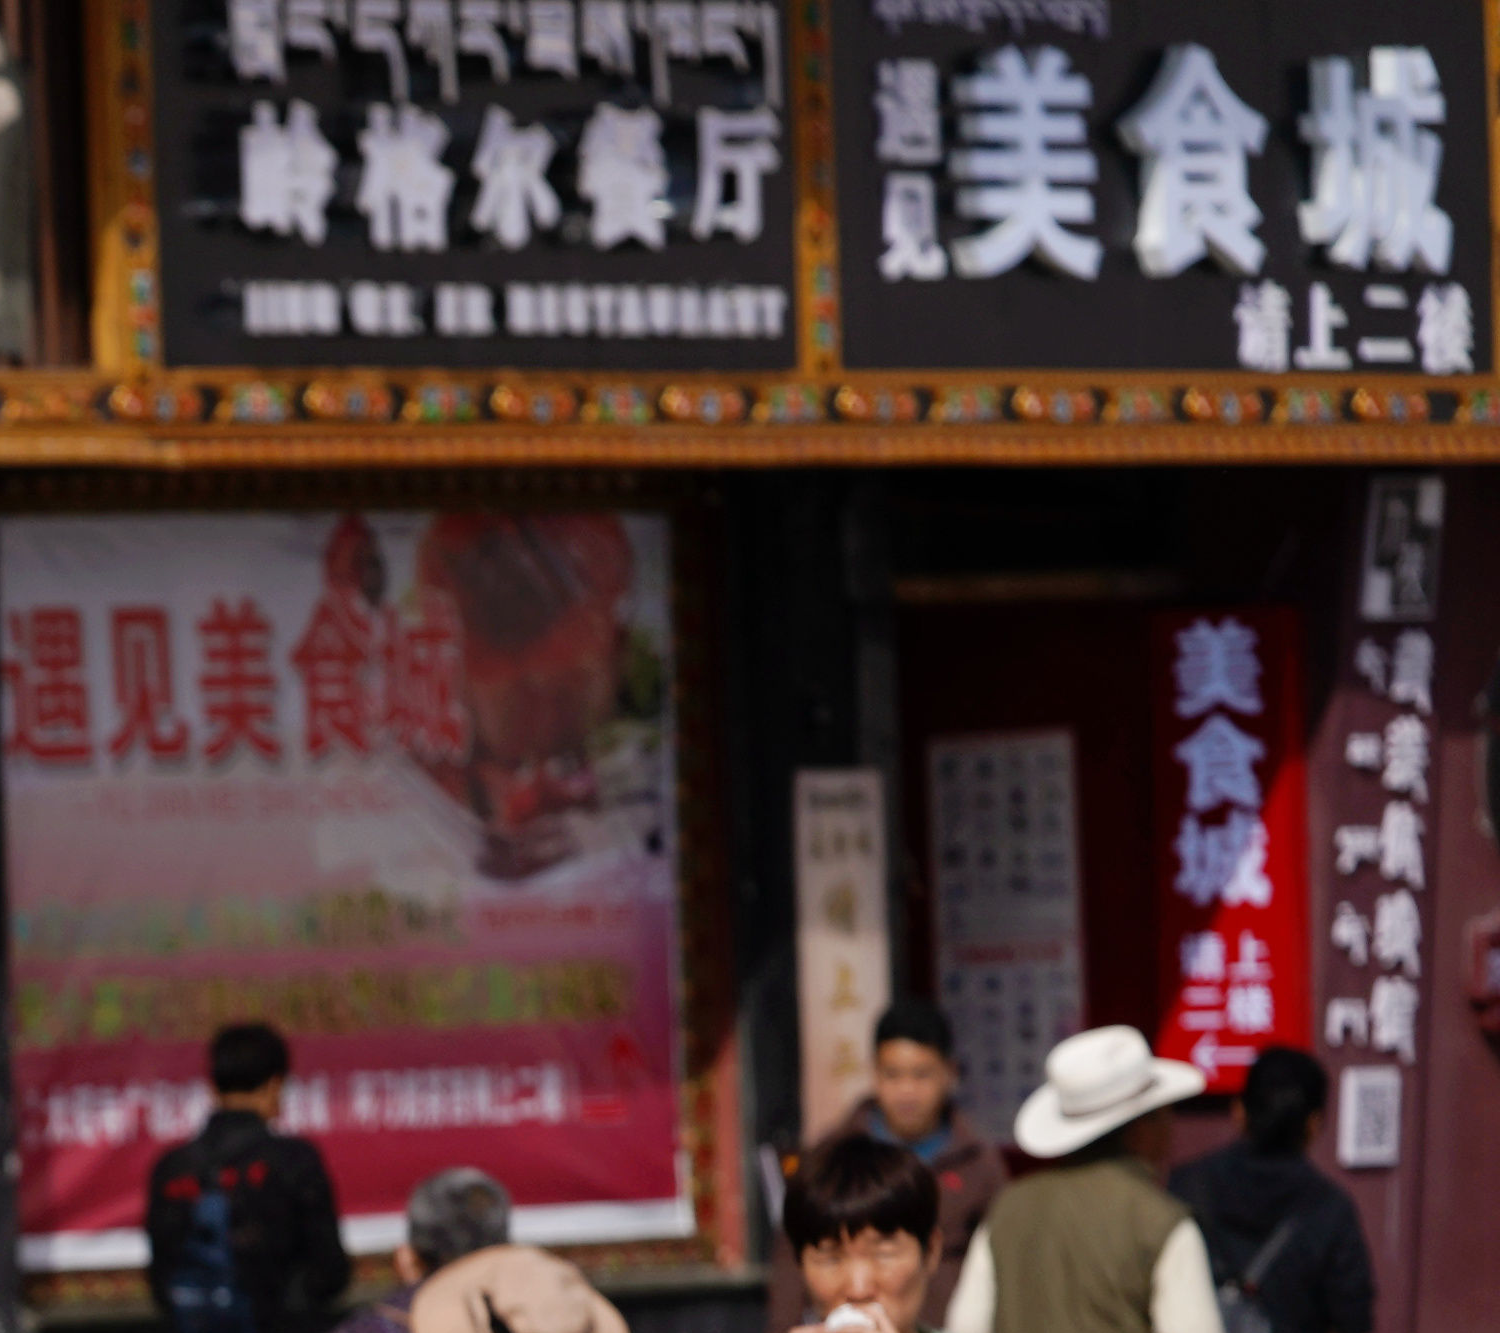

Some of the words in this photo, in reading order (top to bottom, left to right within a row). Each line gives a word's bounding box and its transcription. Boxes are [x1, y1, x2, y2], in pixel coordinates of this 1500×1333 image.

[948, 41, 1455, 282] 美食城
[0, 596, 467, 768] 遇见美食城
[1173, 613, 1271, 910] 美食城
